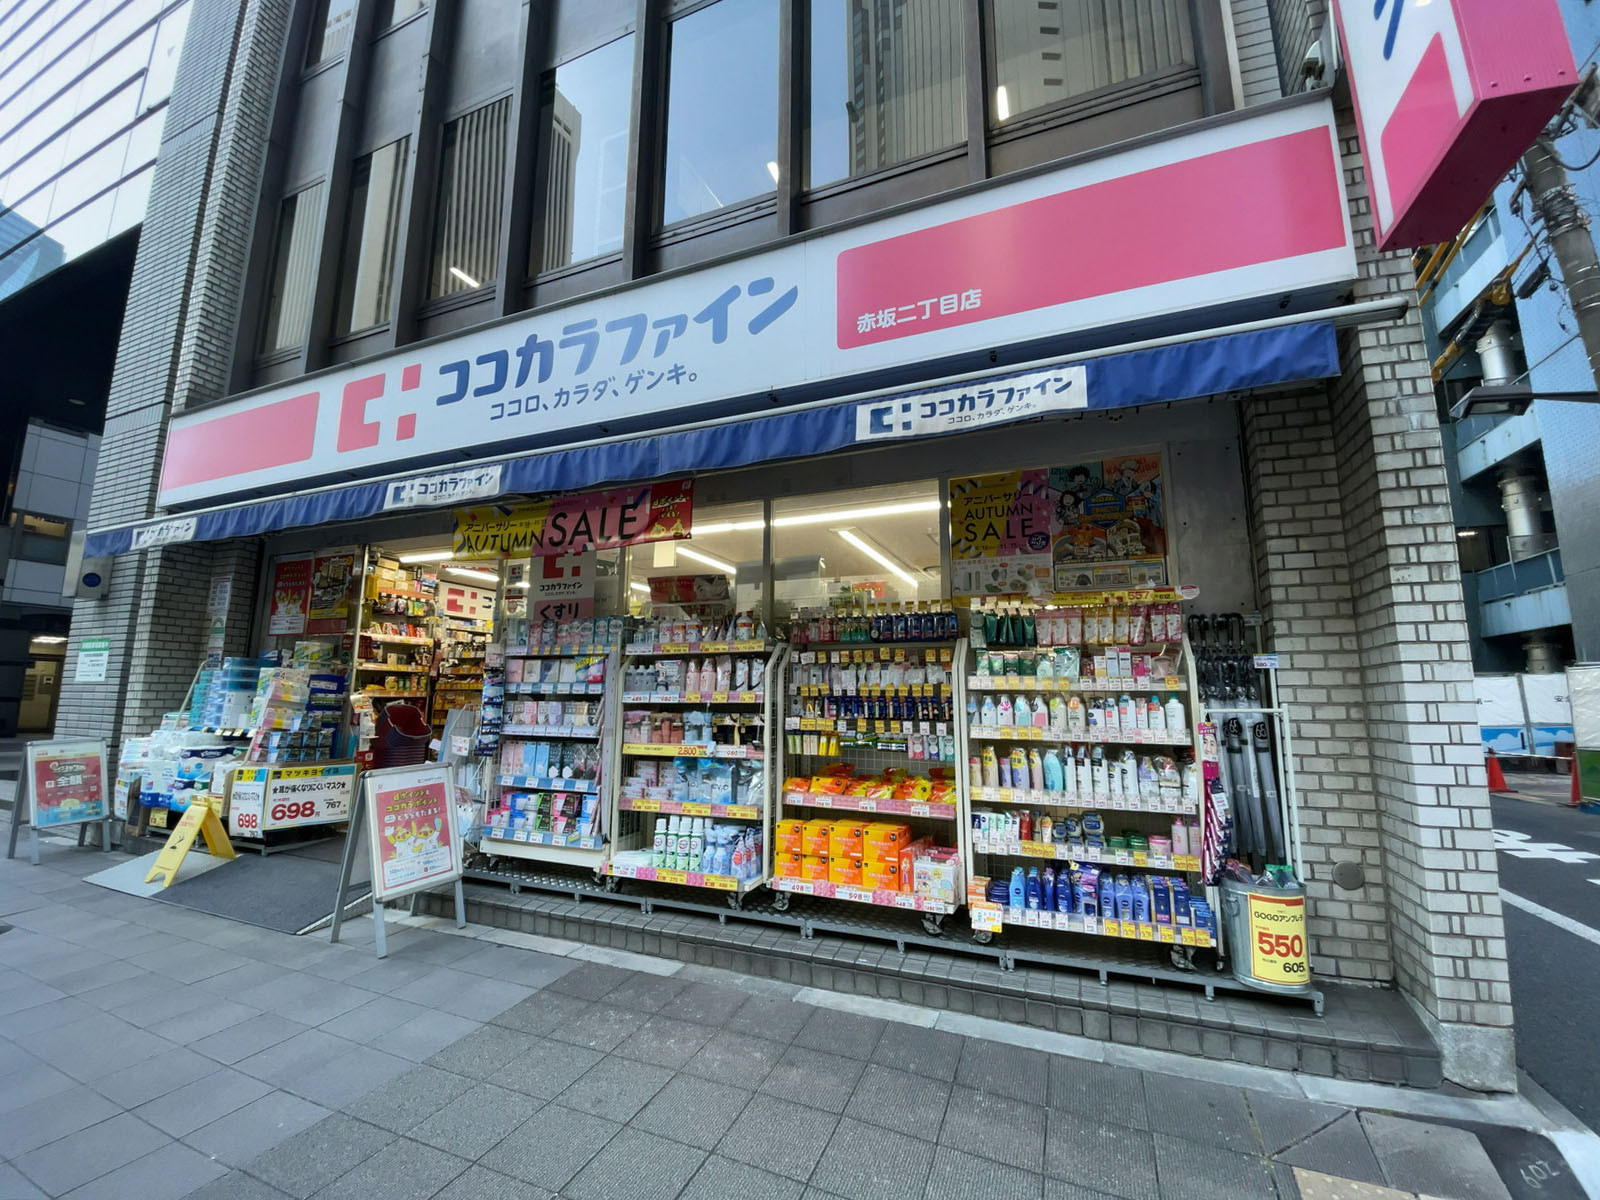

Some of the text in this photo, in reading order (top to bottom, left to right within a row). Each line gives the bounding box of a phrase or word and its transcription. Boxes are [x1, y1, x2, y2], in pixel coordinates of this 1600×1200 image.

[856, 288, 982, 335] 赤坂二丁目店
[436, 276, 799, 407] ココカラファイン
[489, 363, 699, 421] ココロ、カラダ、ゲンキ。
[920, 377, 1073, 419] ココカラファイン
[963, 489, 1033, 506] アニバーサリー
[964, 503, 1033, 521] AUTUMN
[464, 520, 518, 533] アニバーサリー
[466, 530, 546, 553] AUTUMN
[549, 502, 638, 547] SALE
[964, 517, 1034, 543] SALE
[540, 602, 580, 620] くすり
[238, 813, 258, 829] 698
[271, 801, 315, 821] 698
[1253, 910, 1304, 923] GOGOアンブレラ
[1257, 930, 1304, 958] 550
[1282, 961, 1305, 973] 605
